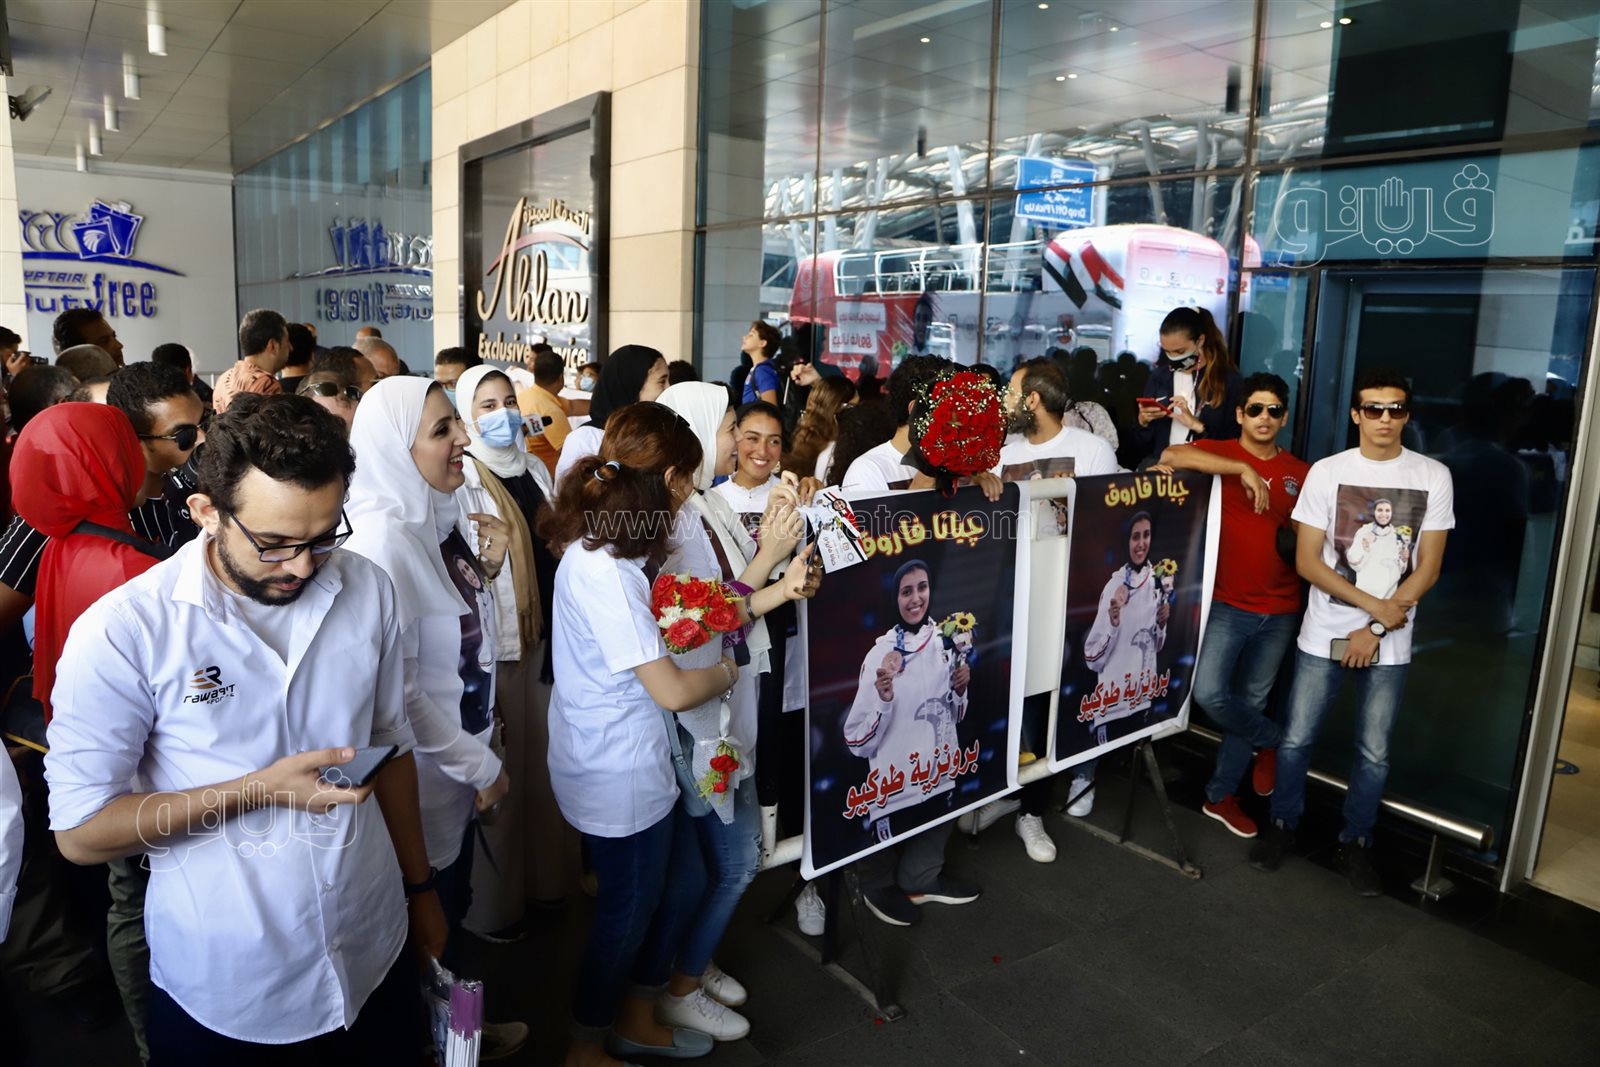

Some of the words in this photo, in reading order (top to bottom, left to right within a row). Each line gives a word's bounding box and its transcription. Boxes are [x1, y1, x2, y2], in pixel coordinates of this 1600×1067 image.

[477, 197, 589, 324] Ahlan
[93, 273, 155, 318] free
[478, 331, 531, 365] Exclusive
[1105, 475, 1152, 507] فاروق
[1077, 680, 1121, 722] طوكيو
[1123, 668, 1171, 710] برونزية
[909, 739, 980, 793] برونزية
[843, 763, 905, 819] طوكيو
